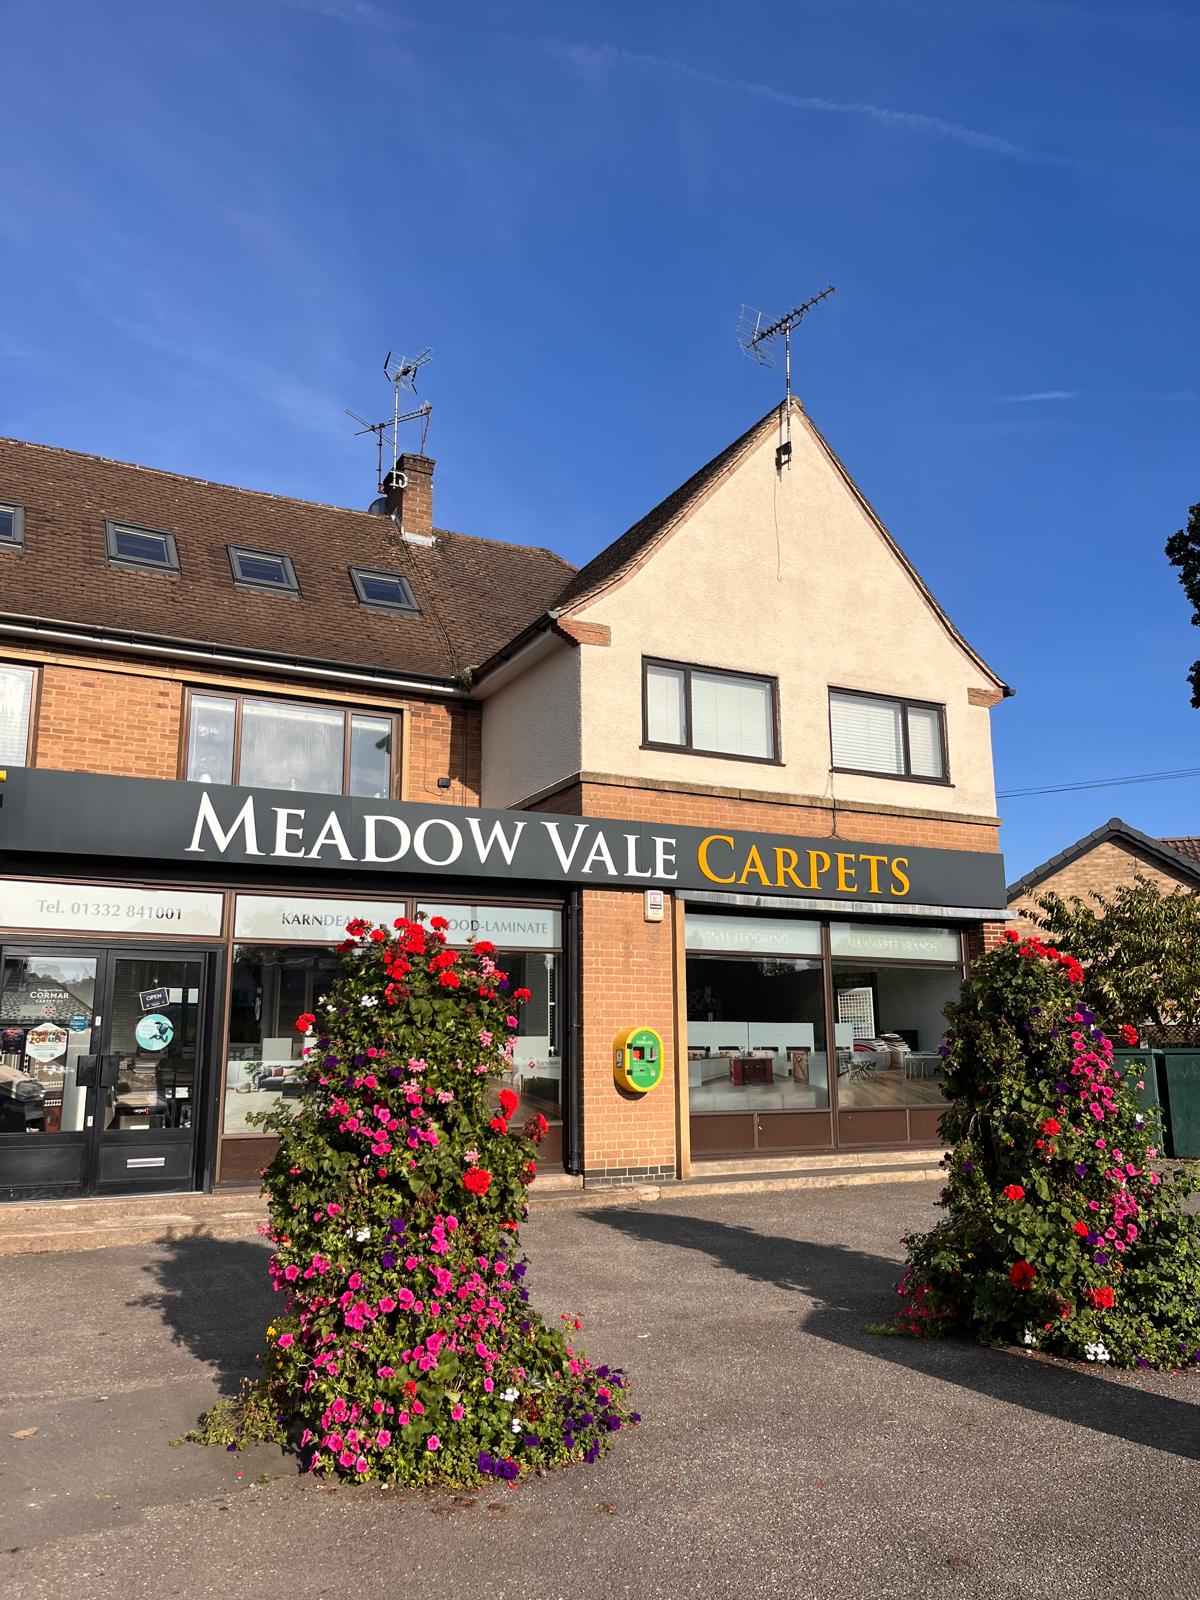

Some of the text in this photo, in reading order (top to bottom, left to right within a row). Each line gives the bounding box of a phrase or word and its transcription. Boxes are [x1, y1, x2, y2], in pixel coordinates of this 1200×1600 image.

[184, 791, 910, 896] MEADOW VALE CARPETS
[37, 900, 182, 920] Tel. 01332 841001
[446, 919, 548, 934] OOD-LAMINATE
[30, 991, 69, 999] CORMAR
[145, 993, 162, 1001] OPEN
